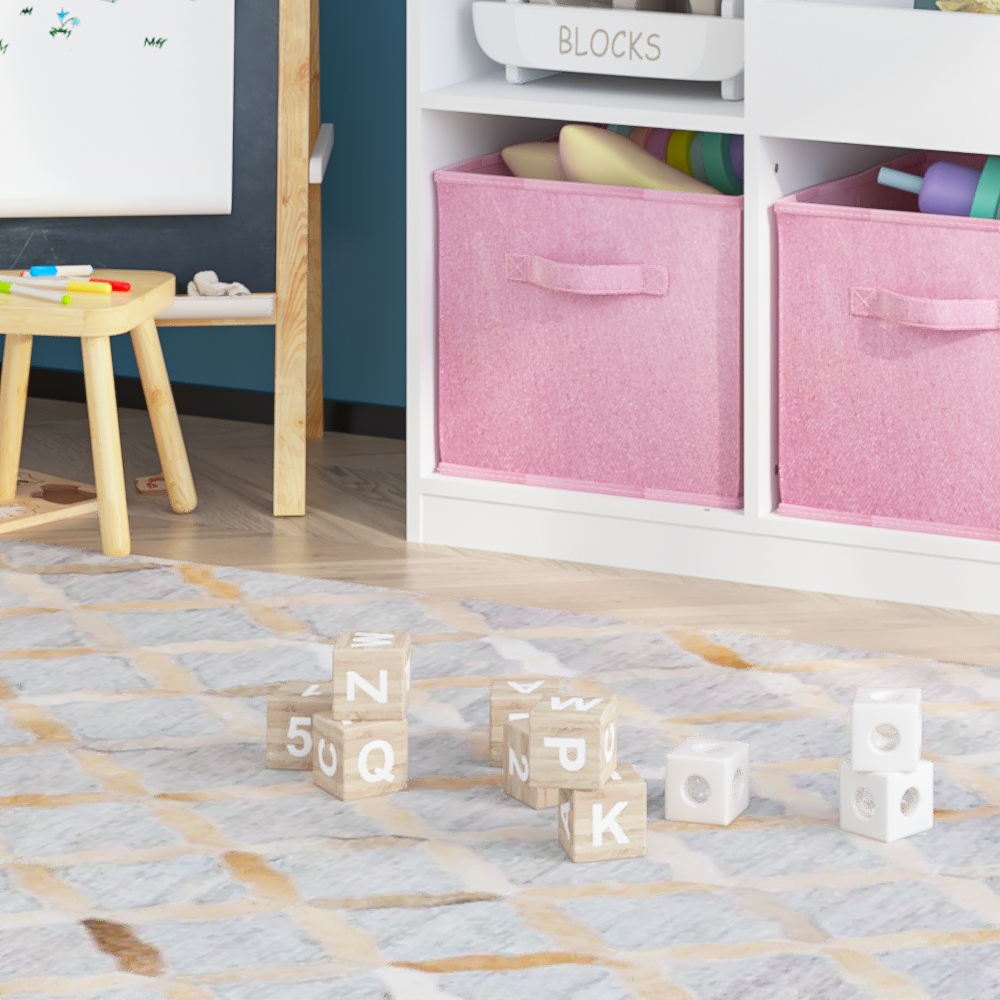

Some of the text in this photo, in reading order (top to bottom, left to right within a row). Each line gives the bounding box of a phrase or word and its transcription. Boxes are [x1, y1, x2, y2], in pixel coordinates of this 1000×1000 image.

[558, 24, 662, 62] BLOCKS
[346, 669, 388, 703] N
[286, 716, 313, 757] 5
[543, 737, 586, 772] P
[358, 739, 395, 783] Q
[592, 800, 631, 847] K
